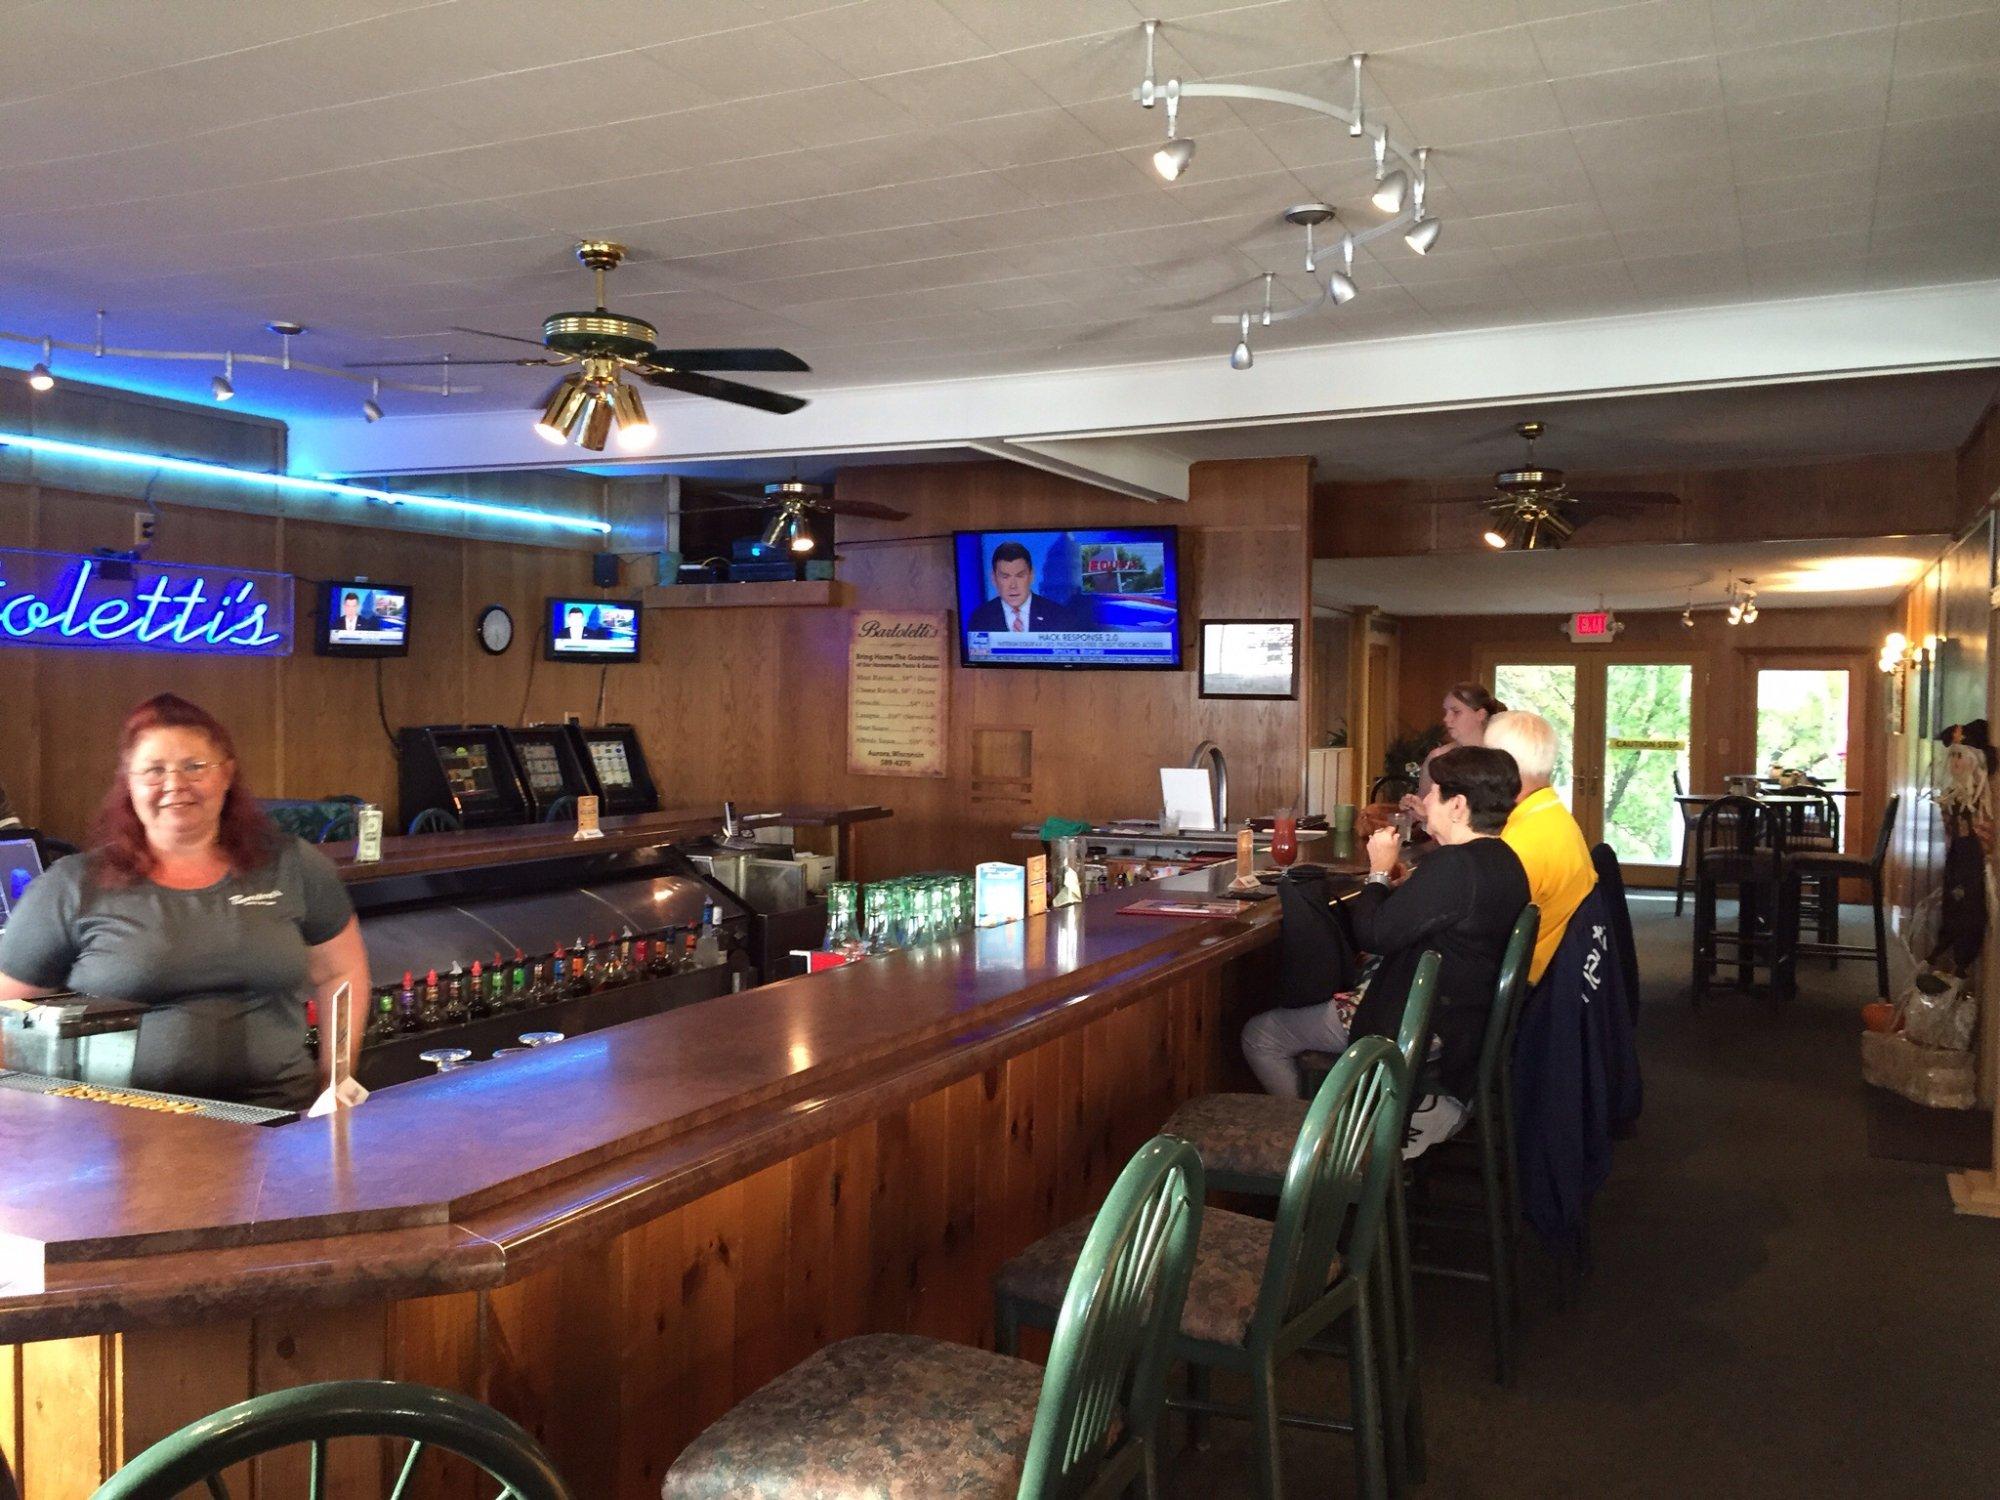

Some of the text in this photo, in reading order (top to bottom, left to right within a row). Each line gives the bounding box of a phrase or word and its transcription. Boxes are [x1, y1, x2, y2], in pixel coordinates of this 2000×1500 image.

[0, 560, 280, 646] oletti's
[858, 619, 939, 638] Bartoletti's
[1038, 633, 1059, 641] HACK
[1062, 633, 1103, 641] RESPONSE
[1616, 740, 1680, 749] CAUTION STEP
